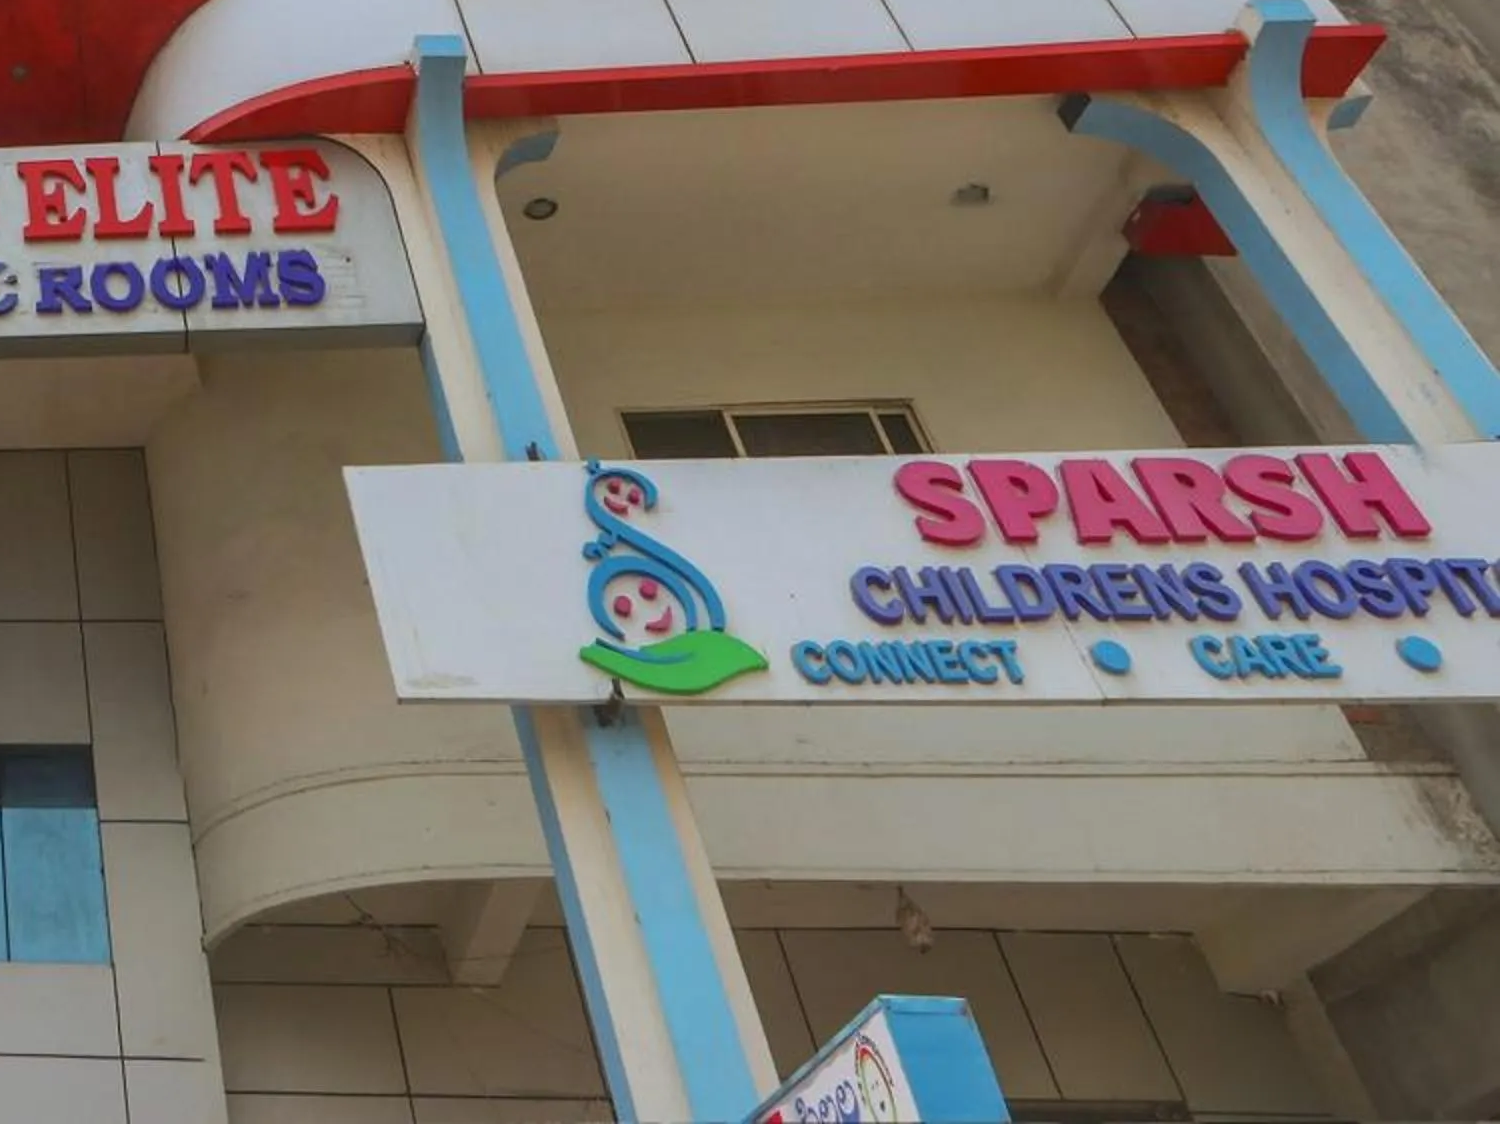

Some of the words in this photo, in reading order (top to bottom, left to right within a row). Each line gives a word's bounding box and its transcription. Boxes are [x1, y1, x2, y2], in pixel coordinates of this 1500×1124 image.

[16, 149, 339, 243] ELITE
[35, 249, 326, 315] ROOMS
[893, 451, 1433, 547] SPARSH
[850, 562, 1243, 625] CHILDRENS
[1237, 557, 1500, 621] HOSPIT
[790, 639, 1026, 685] CONNECT
[1190, 633, 1344, 680] CARE
